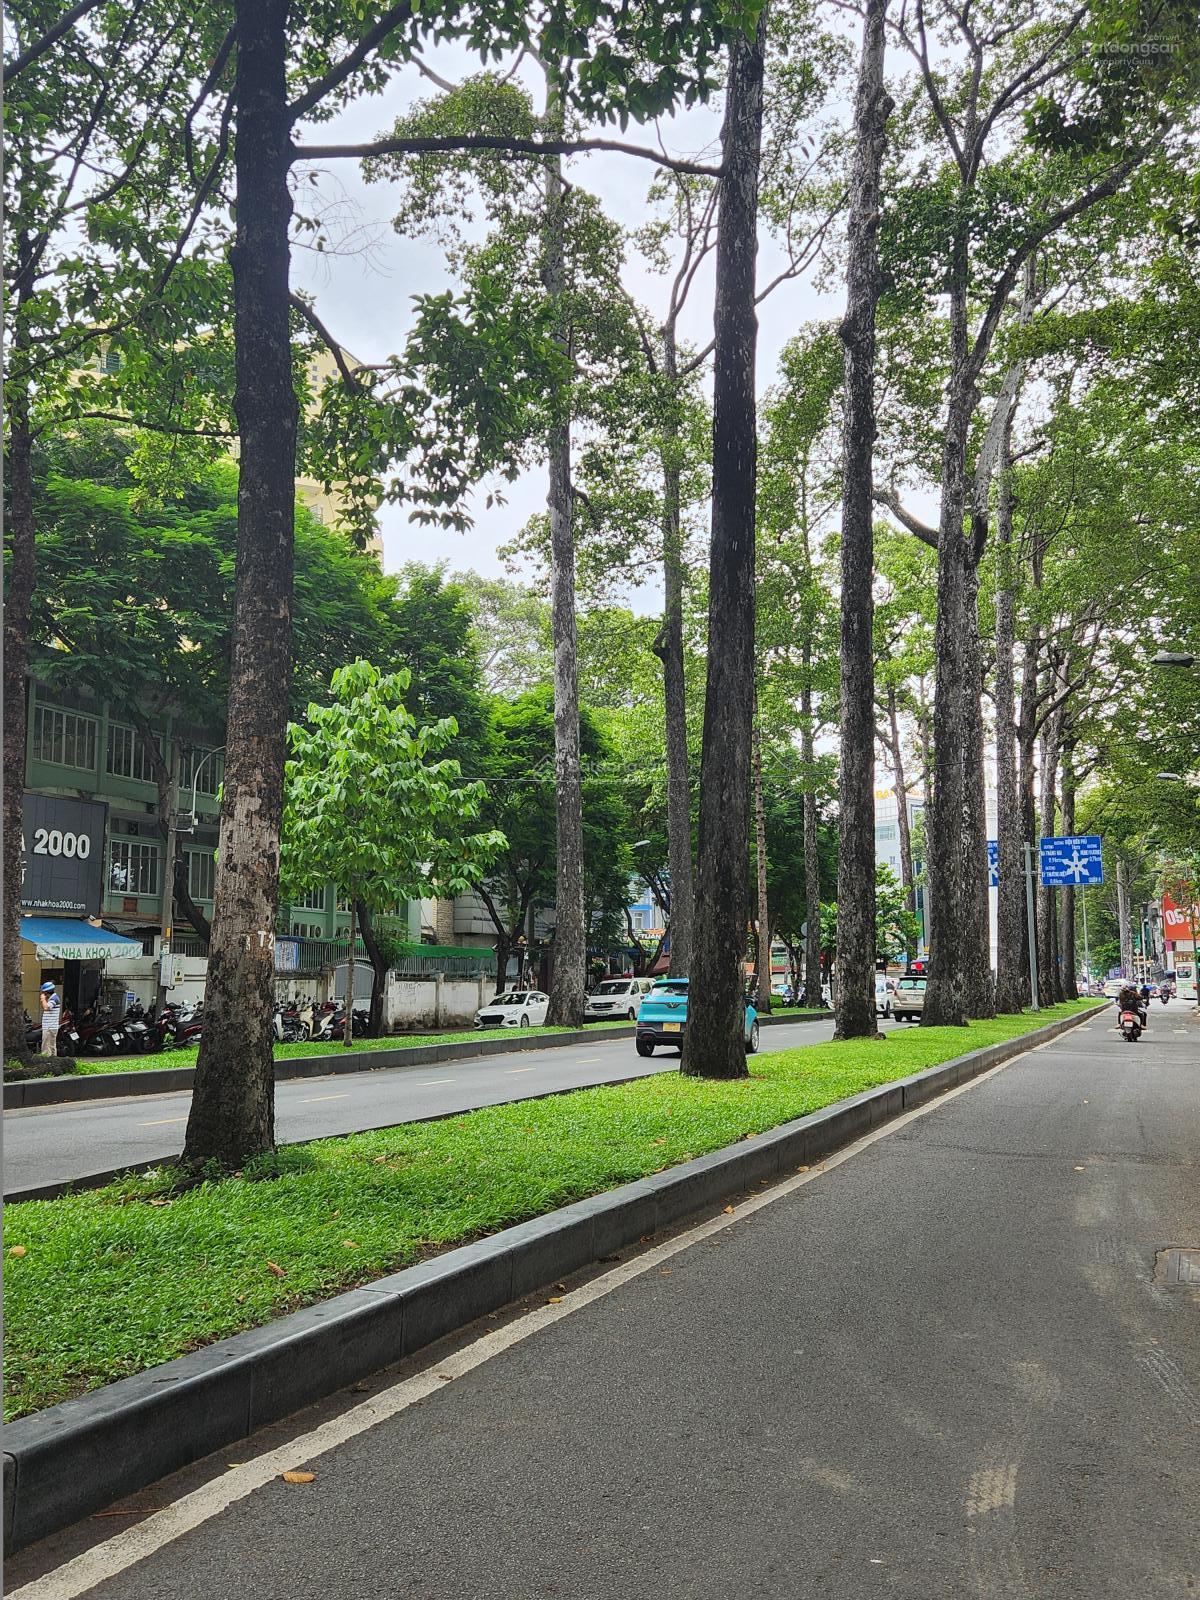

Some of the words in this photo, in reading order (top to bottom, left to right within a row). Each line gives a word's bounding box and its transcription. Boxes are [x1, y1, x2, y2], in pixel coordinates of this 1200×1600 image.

[34, 828, 91, 859] 2000
[61, 947, 82, 959] NHA
[85, 947, 112, 959] KHOA
